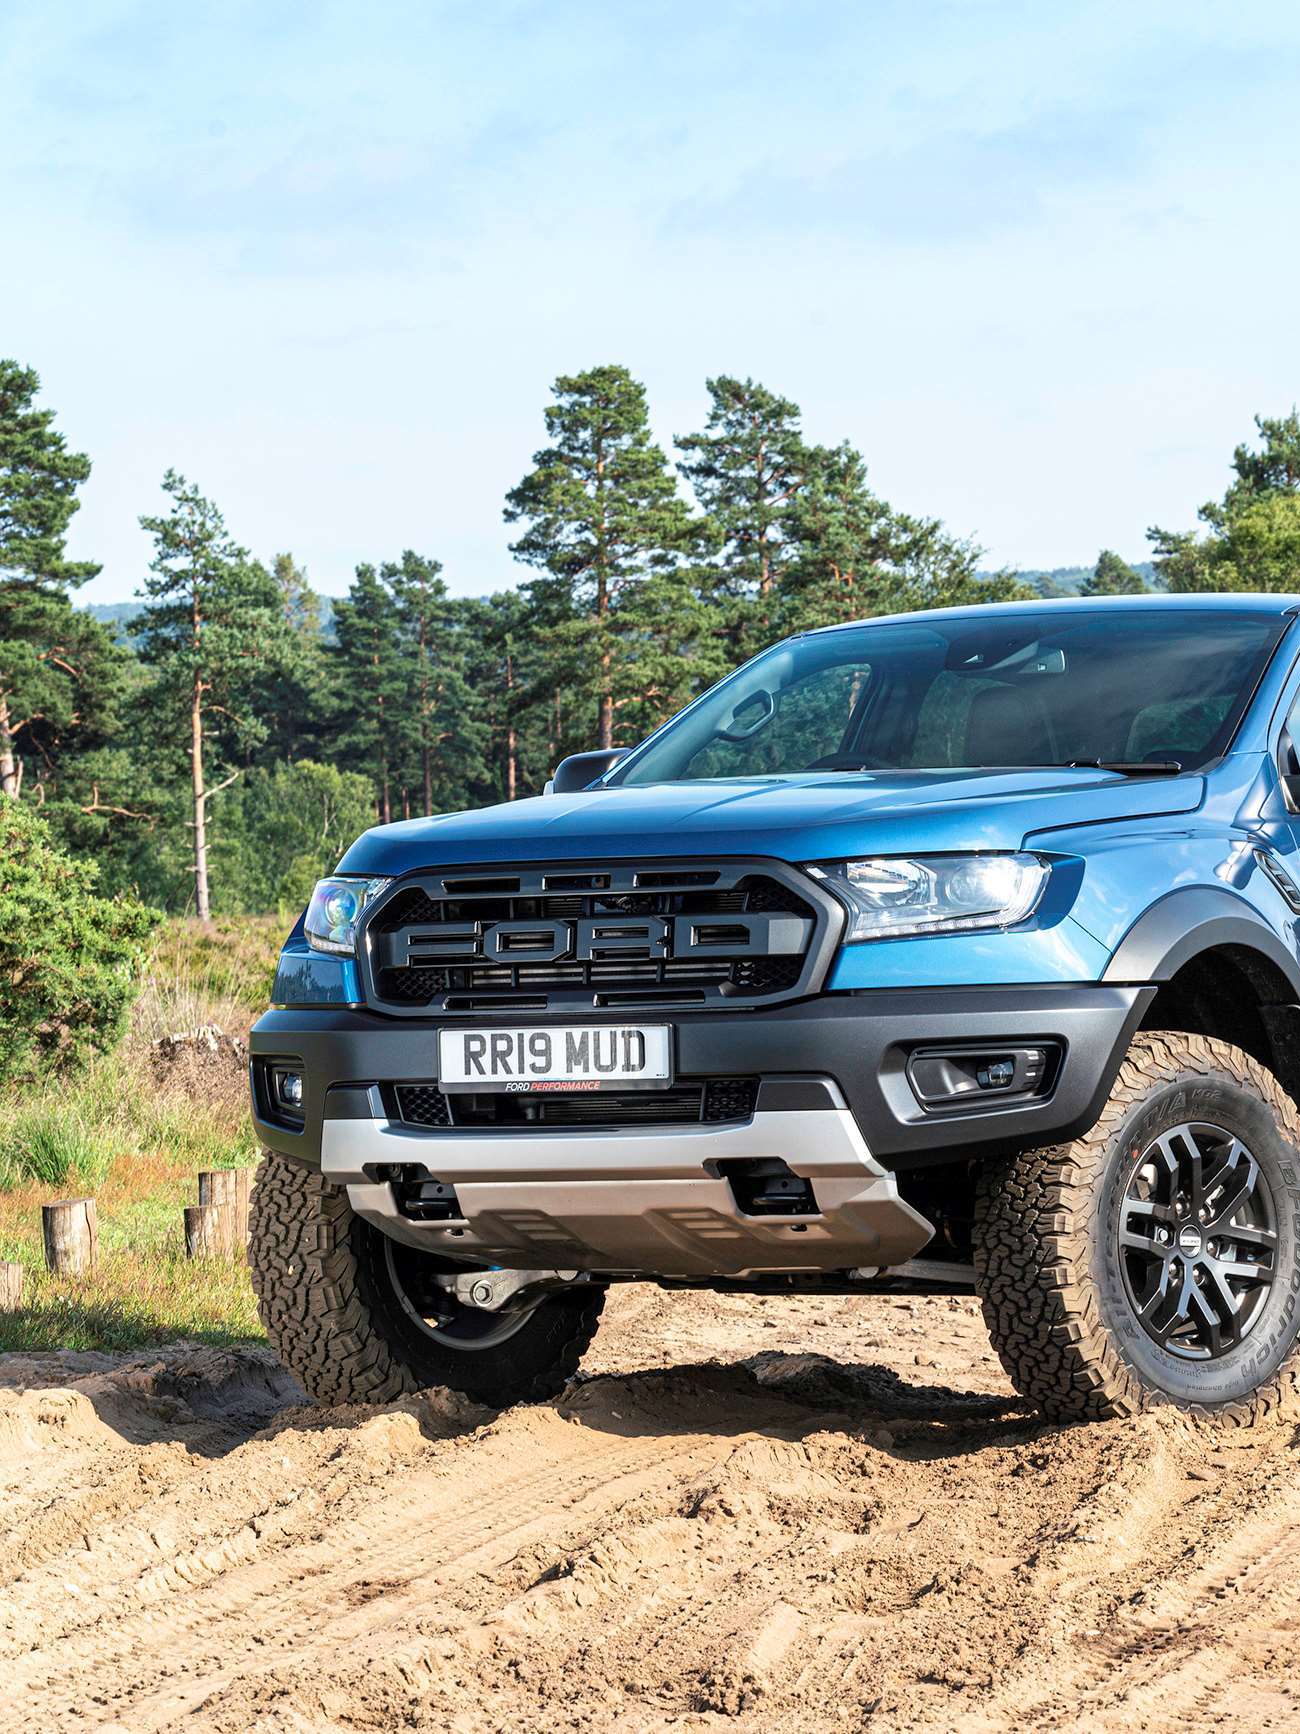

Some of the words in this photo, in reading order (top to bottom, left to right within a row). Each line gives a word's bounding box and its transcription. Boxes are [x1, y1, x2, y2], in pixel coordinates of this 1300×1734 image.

[400, 911, 770, 968] FORD
[463, 1031, 553, 1076] RR19
[565, 1029, 646, 1074] MUD
[505, 1082, 530, 1092] FORD
[530, 1081, 601, 1091] PERFORMANCE
